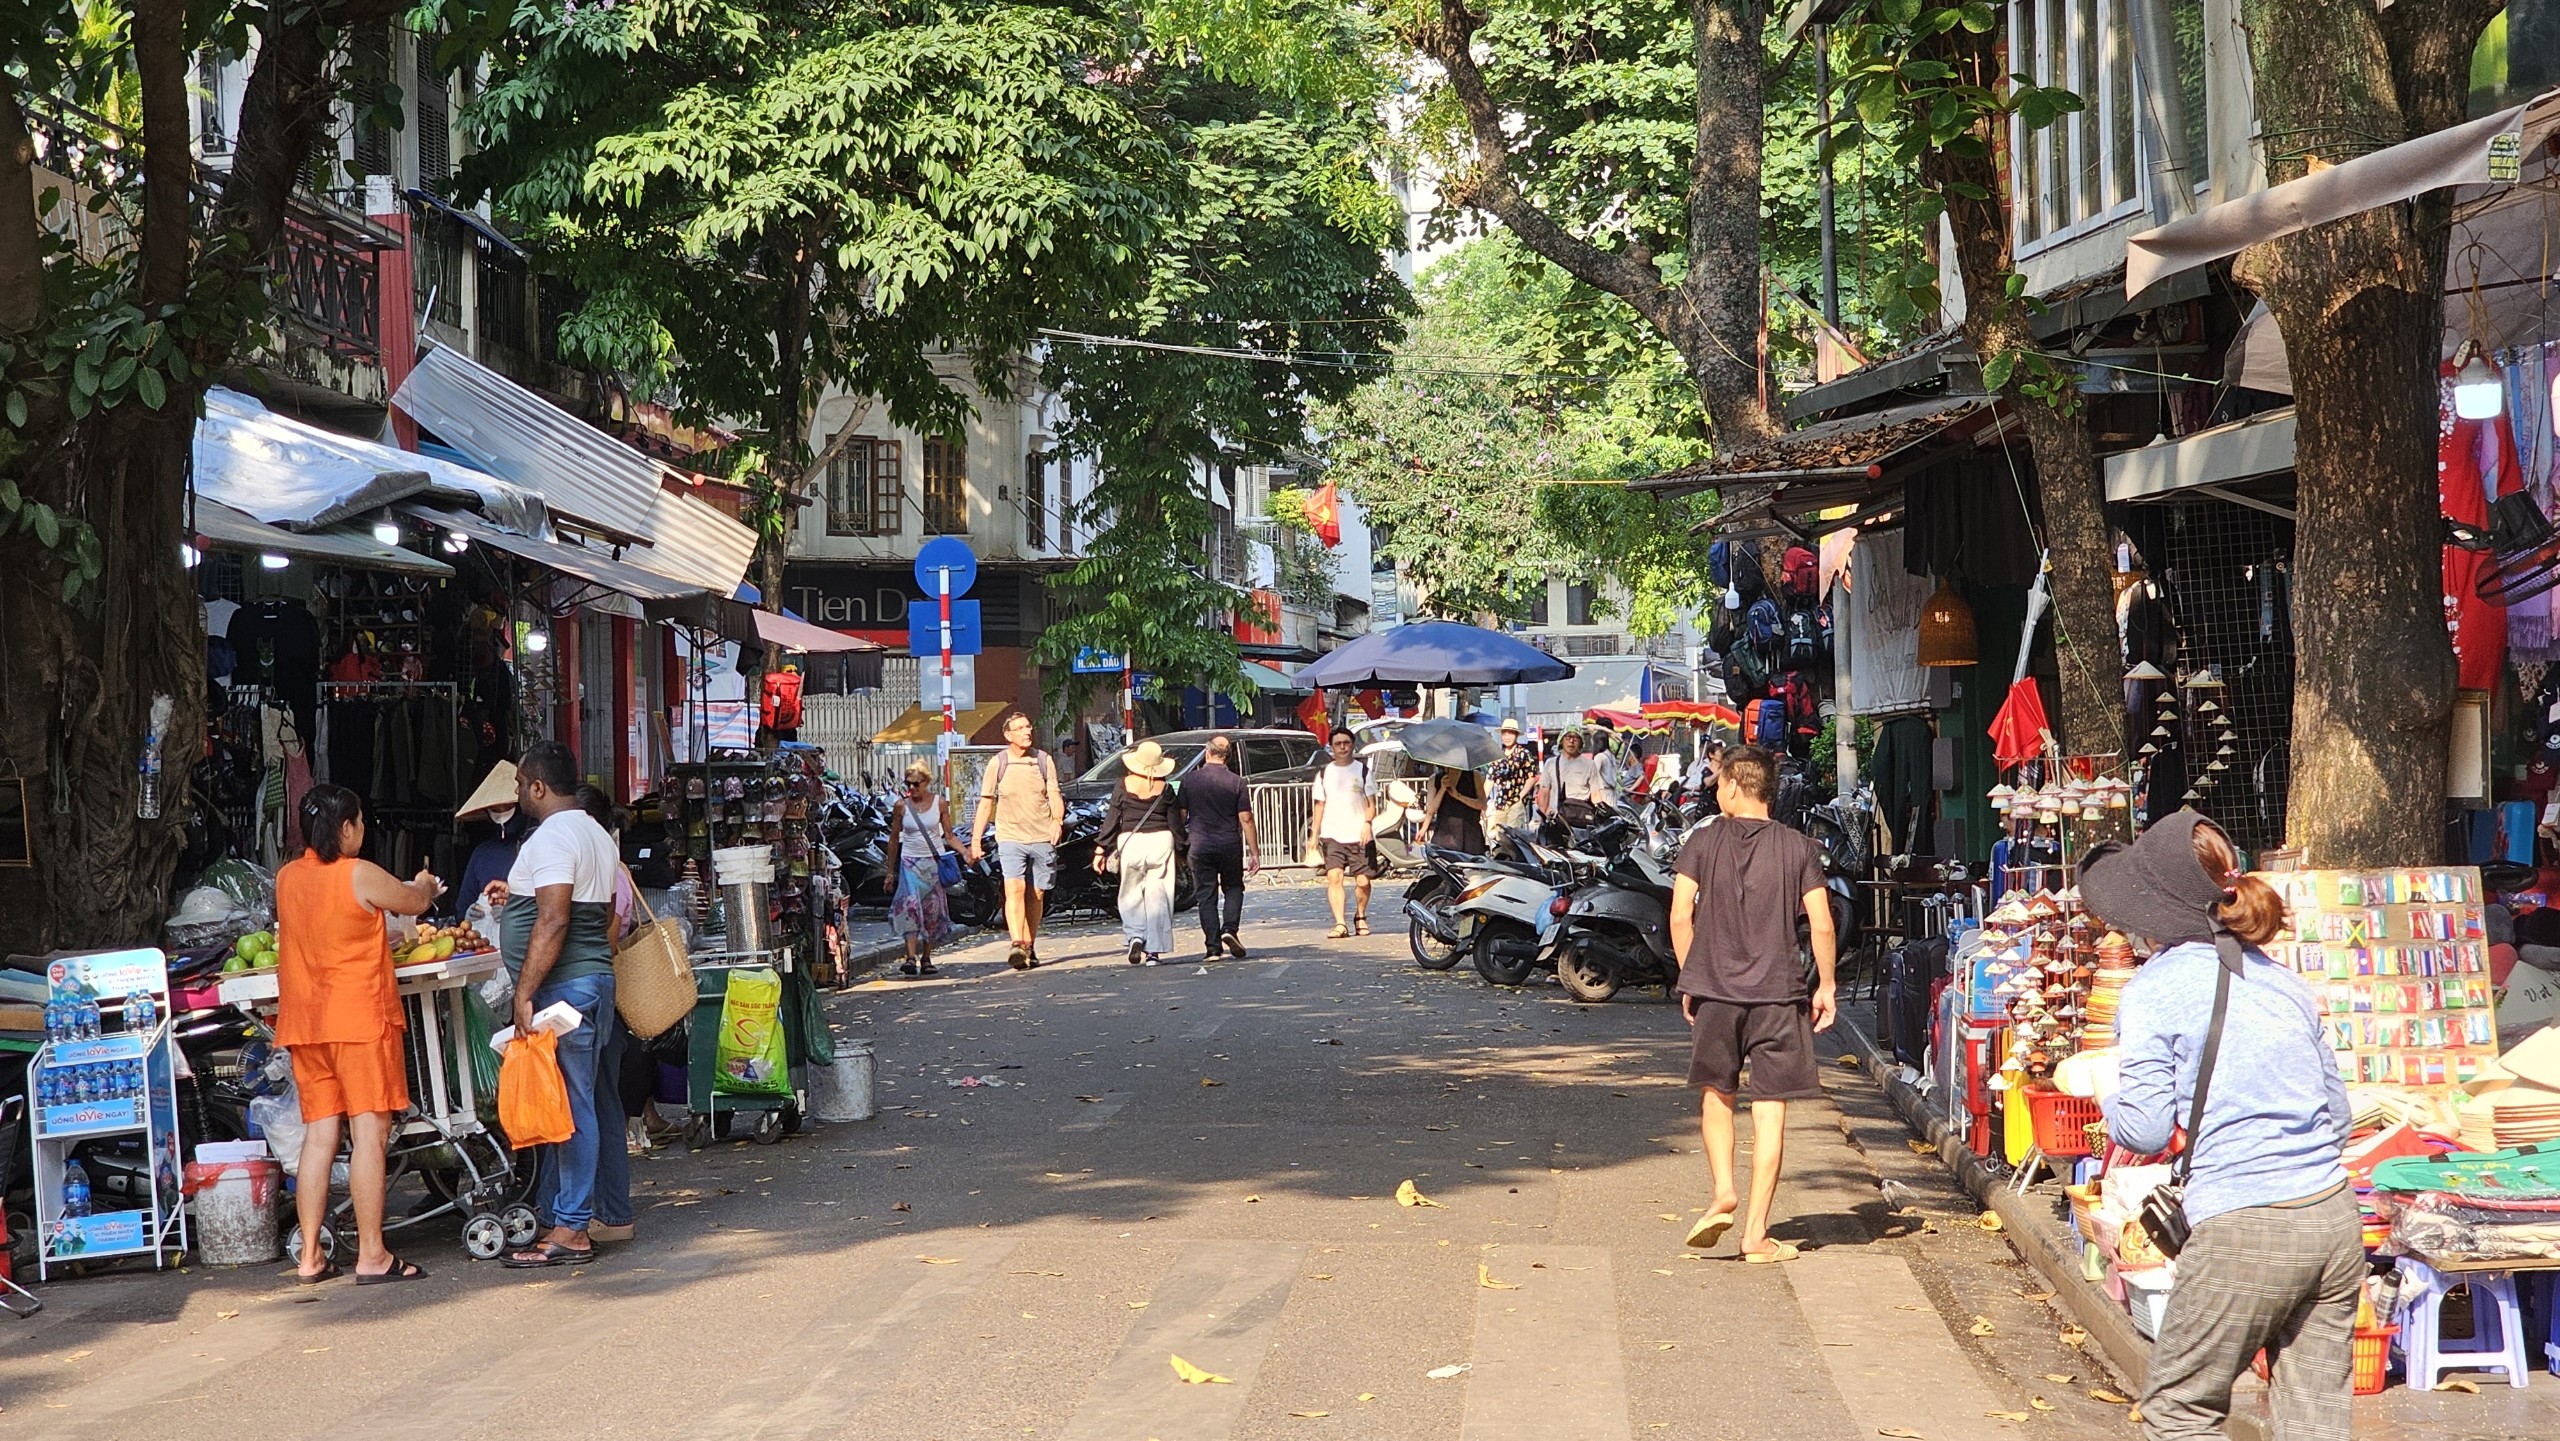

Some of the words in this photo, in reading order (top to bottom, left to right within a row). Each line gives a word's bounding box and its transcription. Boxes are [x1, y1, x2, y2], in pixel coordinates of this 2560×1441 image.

[792, 587, 867, 622] Tien
[877, 588, 909, 622] D
[1657, 682, 1685, 703] COFFEE
[87, 1046, 110, 1058] laVie
[762, 1080, 778, 1090] 25
[51, 1114, 75, 1125] UỐNG
[75, 1110, 103, 1123] laVie
